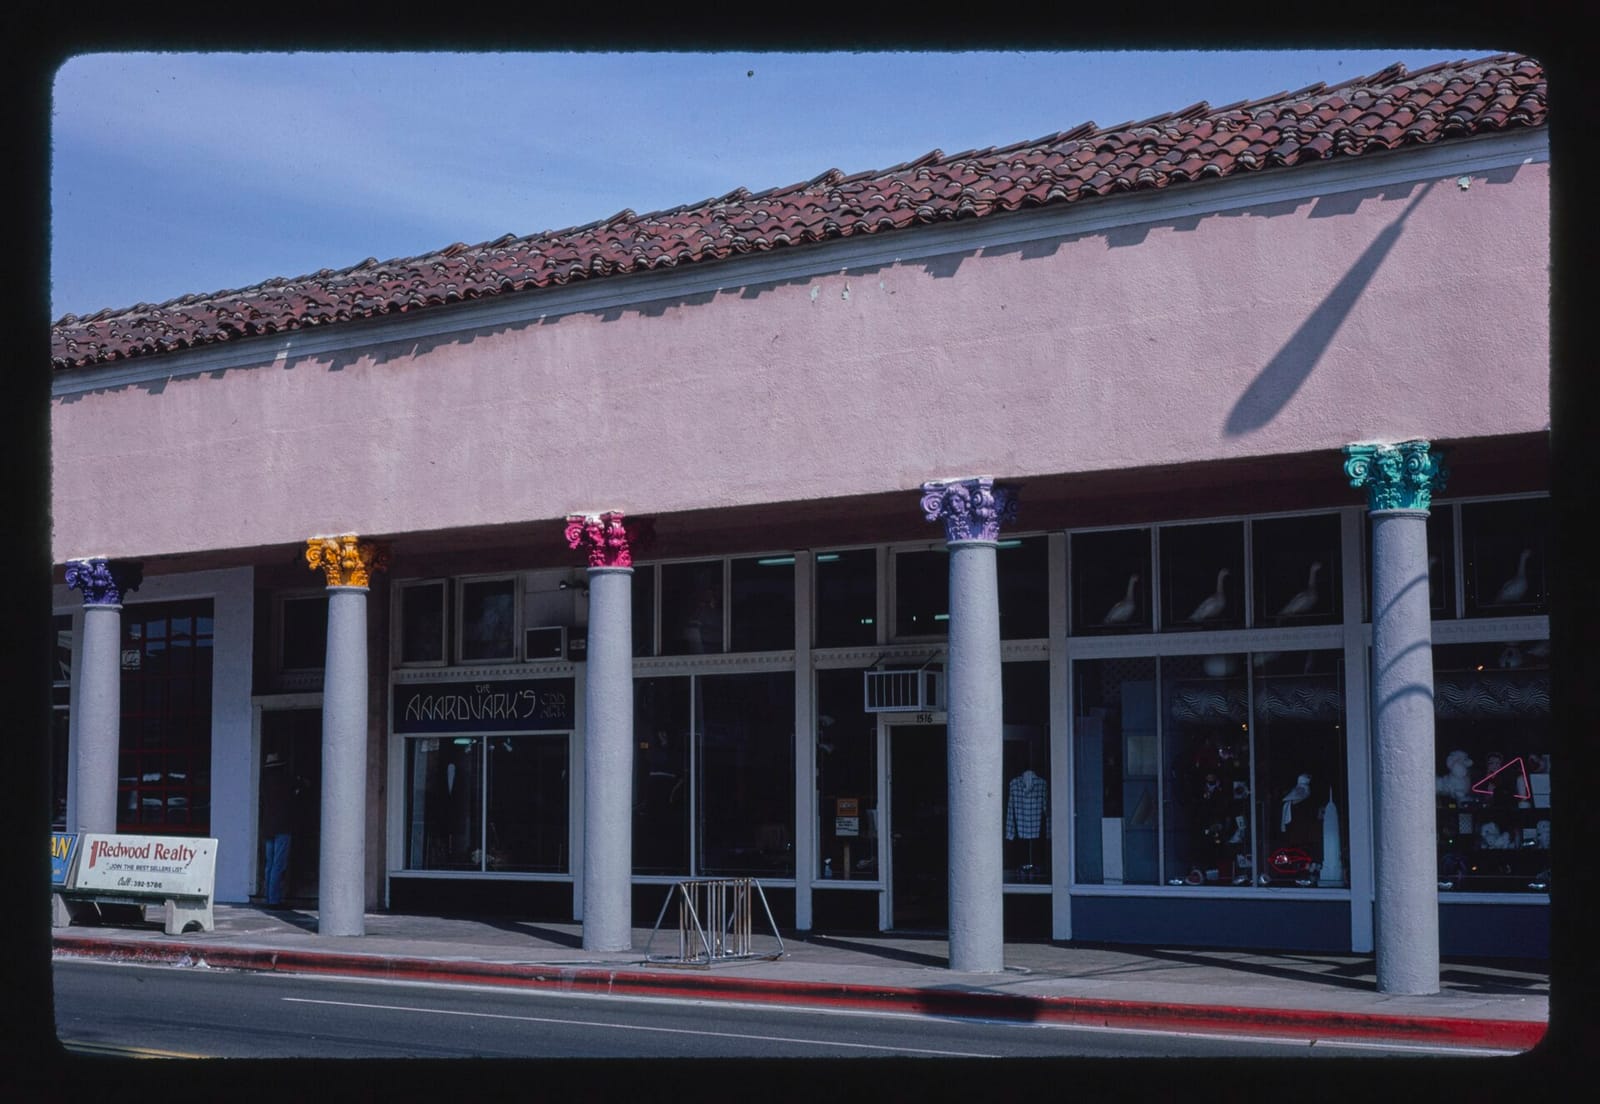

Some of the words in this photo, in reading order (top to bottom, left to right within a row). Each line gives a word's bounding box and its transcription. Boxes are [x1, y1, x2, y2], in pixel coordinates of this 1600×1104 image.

[916, 713, 933, 723] 1516
[98, 840, 151, 859] Redwood
[154, 843, 197, 868] Realty
